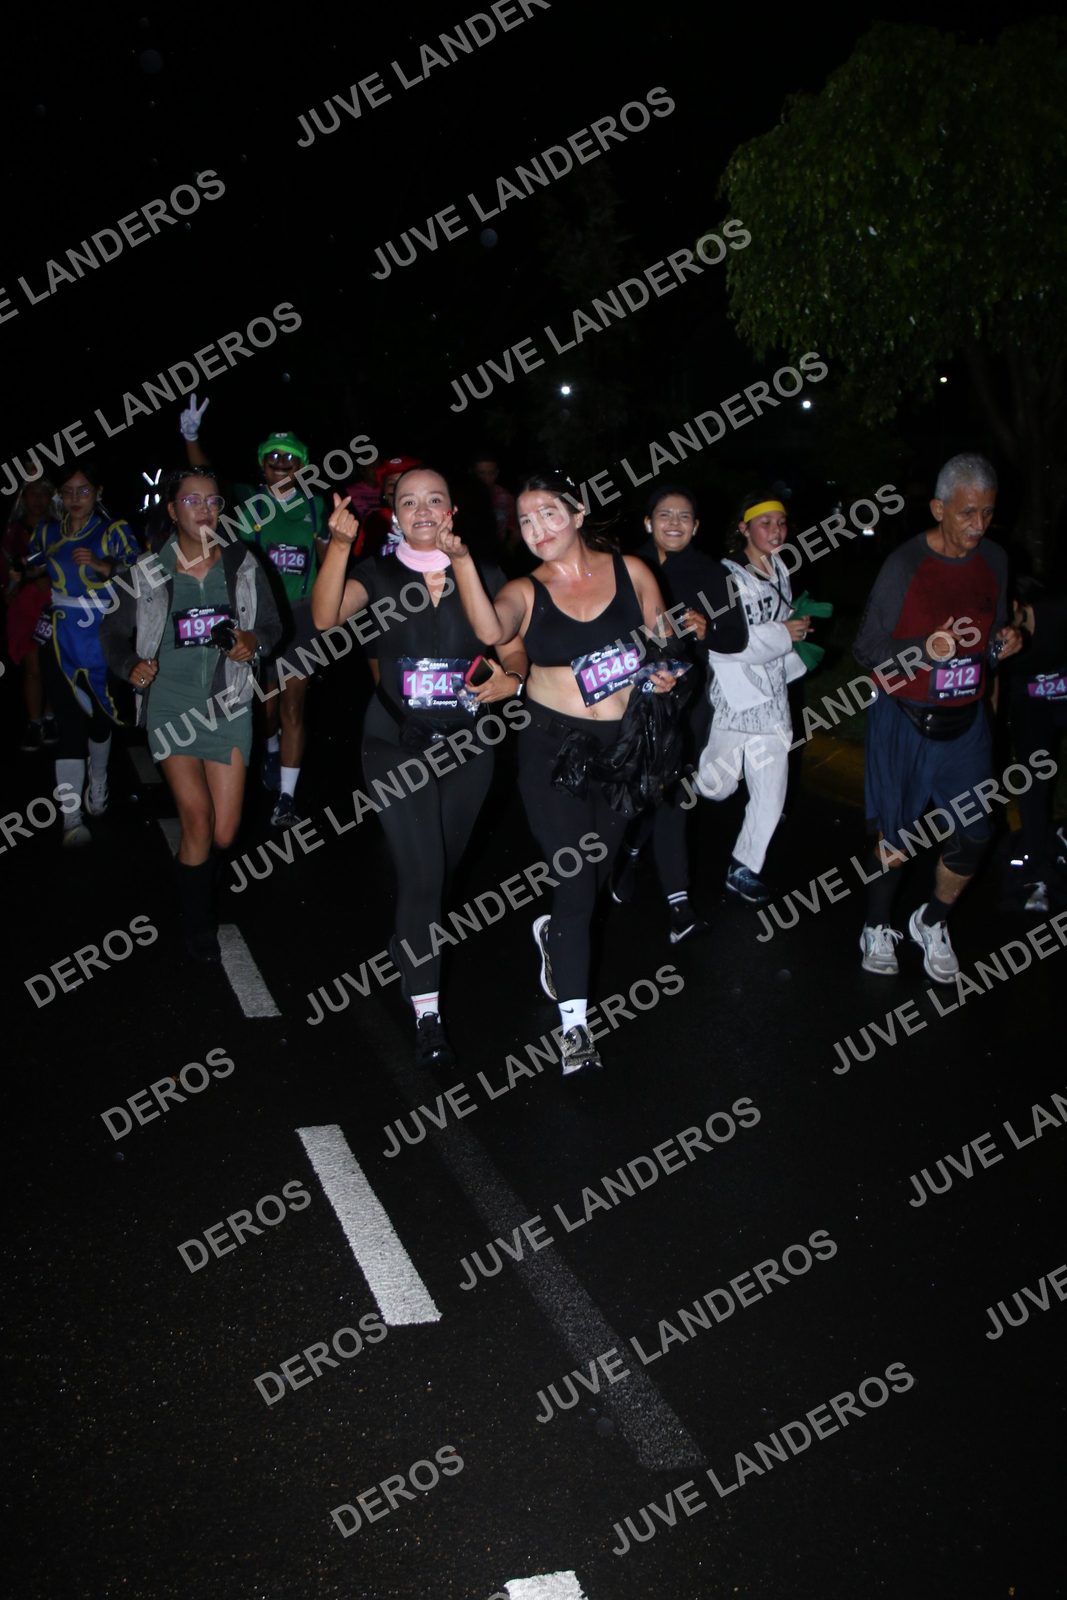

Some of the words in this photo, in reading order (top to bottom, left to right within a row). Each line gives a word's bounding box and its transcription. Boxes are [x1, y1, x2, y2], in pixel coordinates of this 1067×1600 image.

[272, 551, 305, 567] 1126
[183, 616, 225, 637] 191
[585, 652, 638, 688] 1546
[944, 667, 975, 688] 212
[1034, 679, 1067, 696] 424
